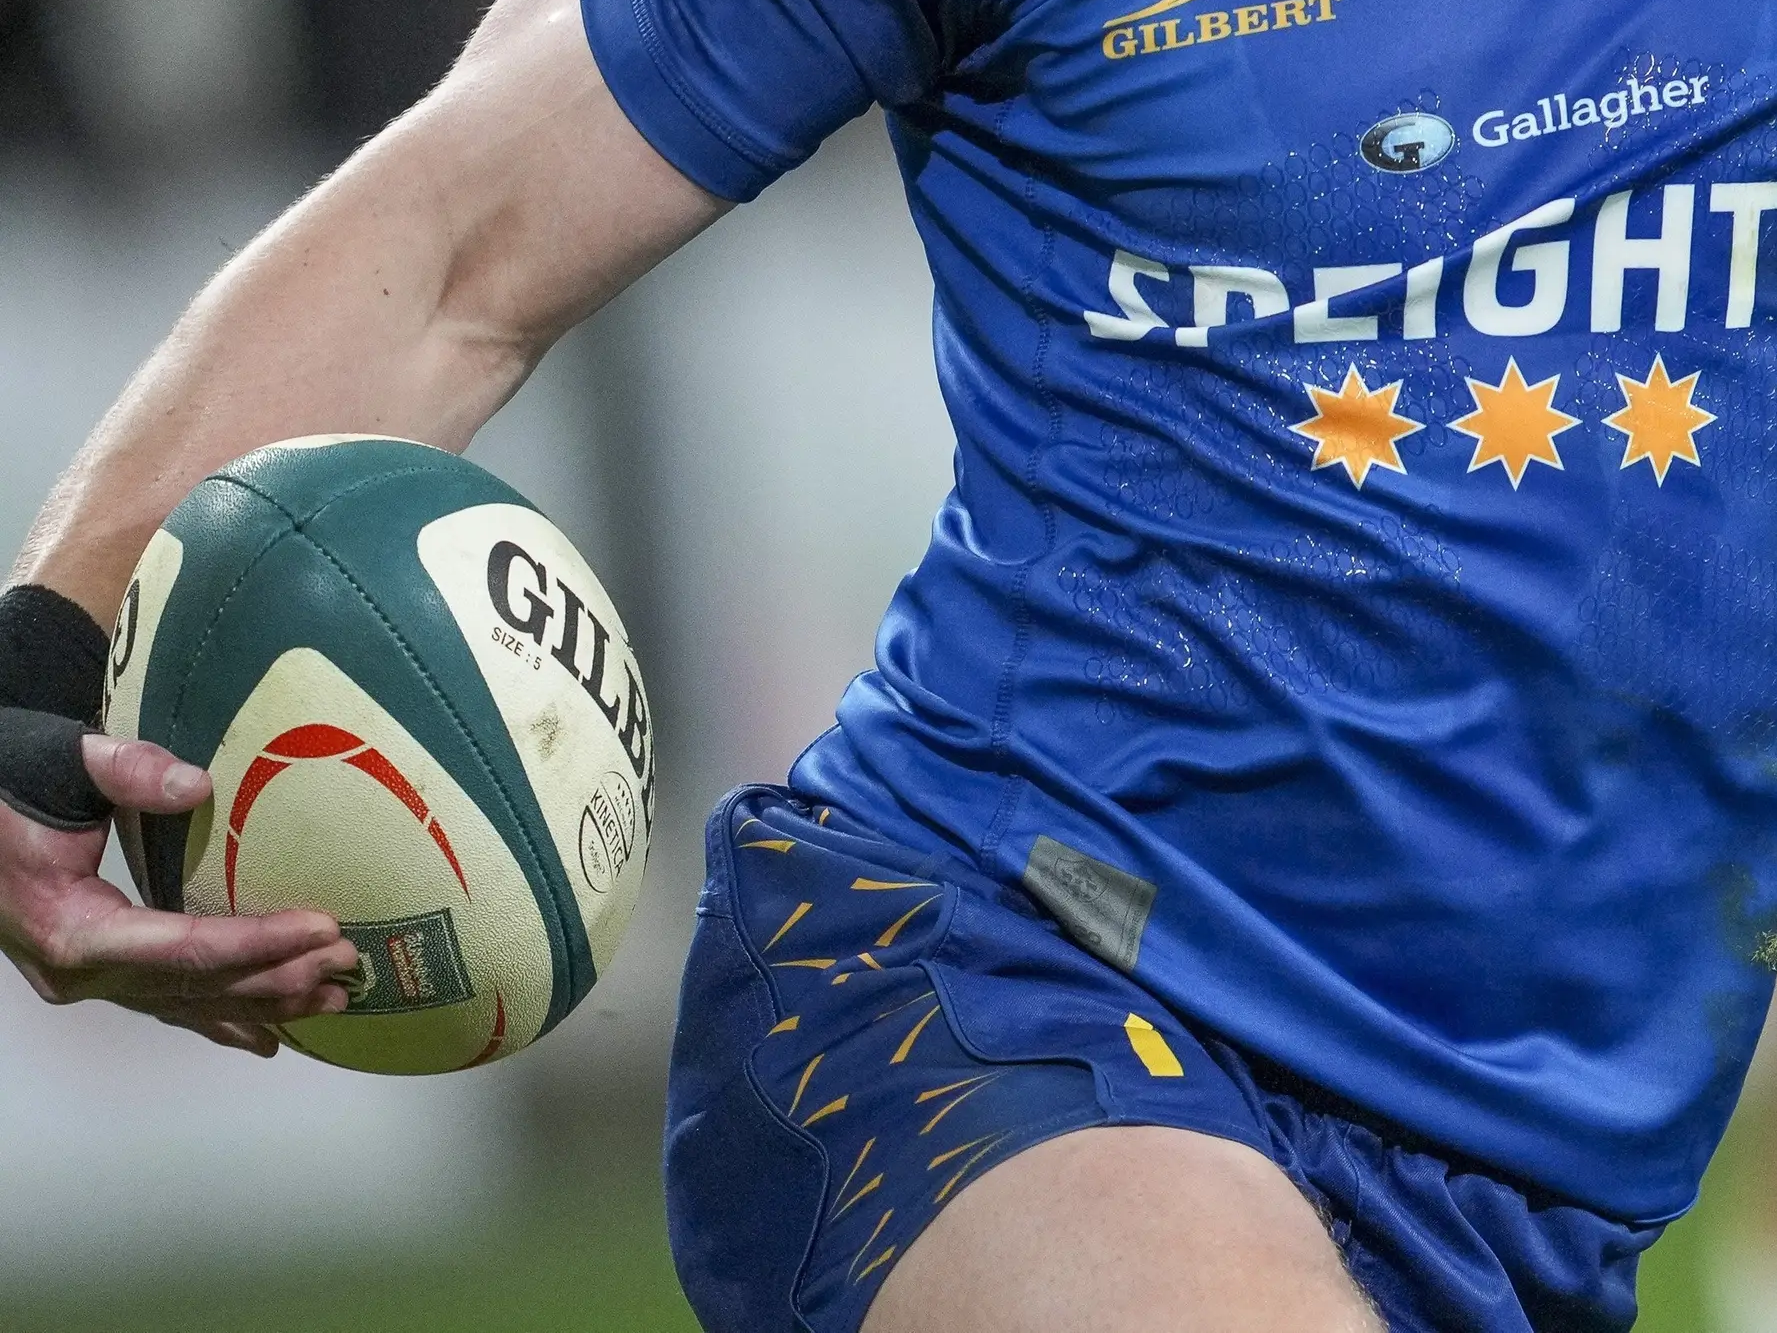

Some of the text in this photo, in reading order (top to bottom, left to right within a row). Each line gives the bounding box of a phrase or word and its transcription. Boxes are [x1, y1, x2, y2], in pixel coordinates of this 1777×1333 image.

[1472, 75, 1709, 148] Gallagher
[491, 627, 525, 657] SIZE
[487, 540, 655, 847] GILB
[590, 788, 624, 878] KINETICA
